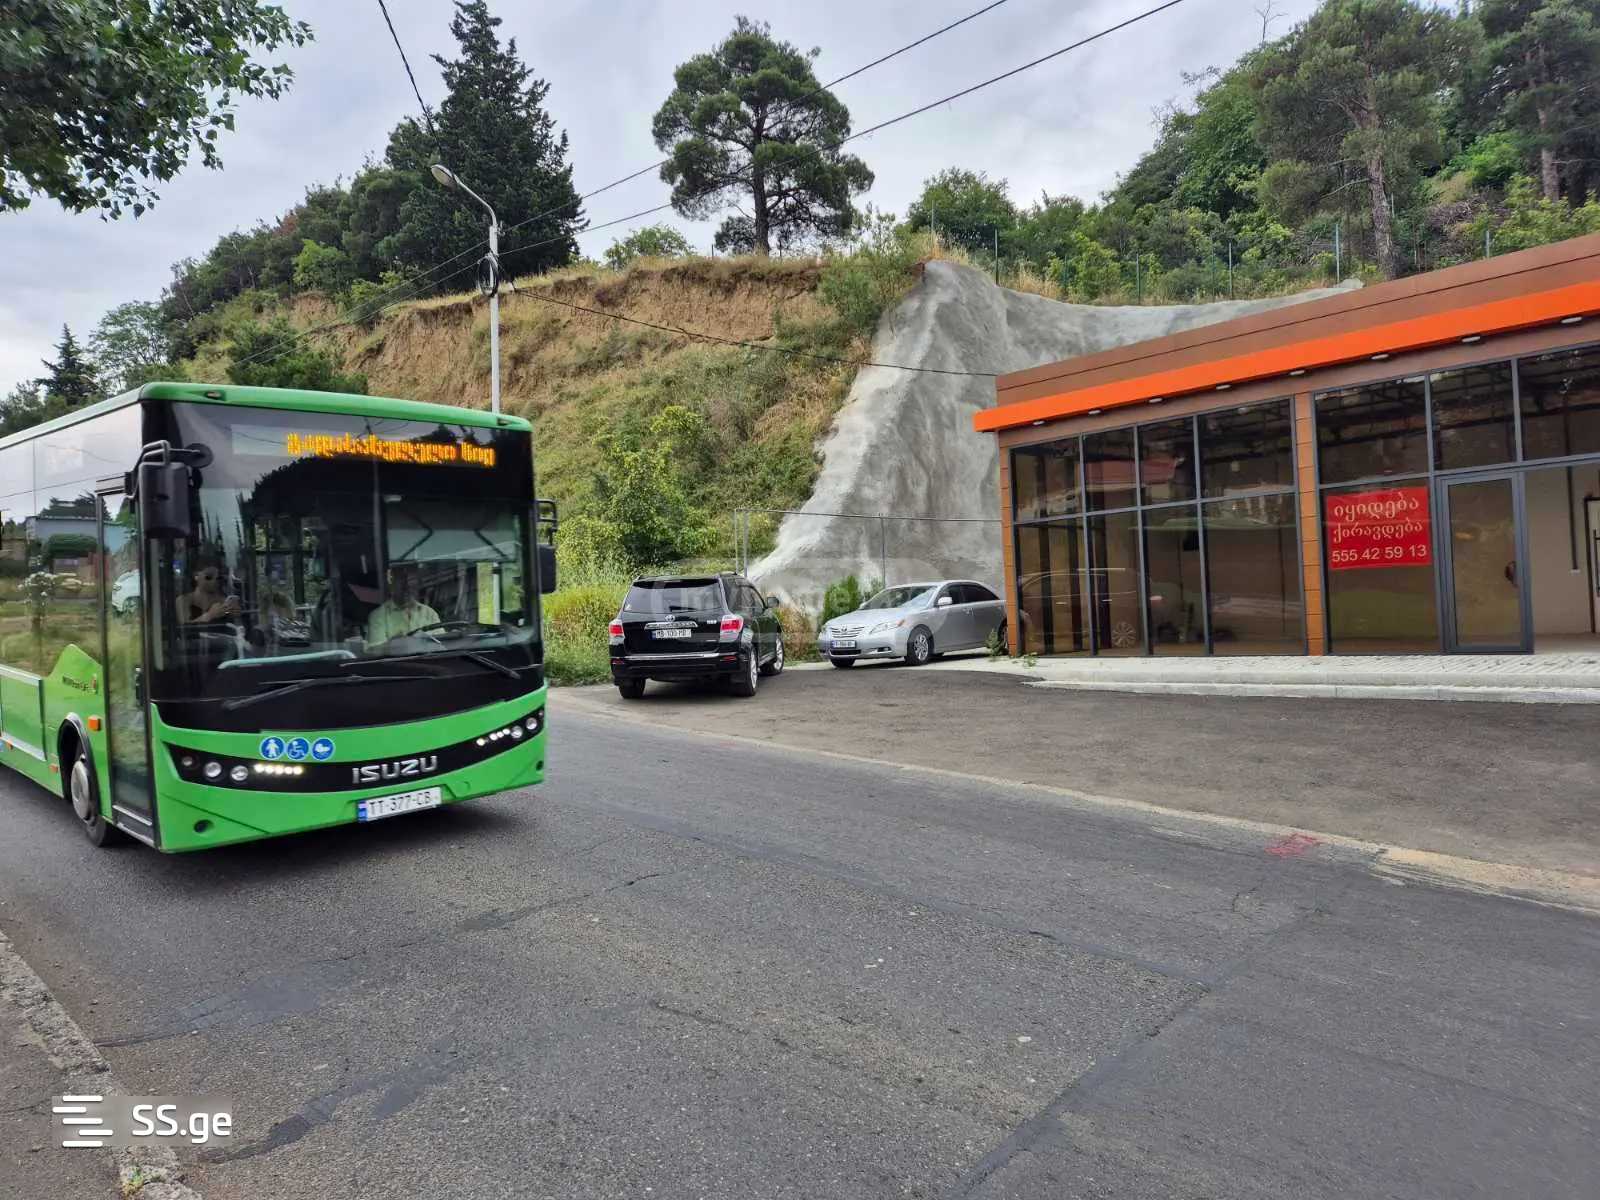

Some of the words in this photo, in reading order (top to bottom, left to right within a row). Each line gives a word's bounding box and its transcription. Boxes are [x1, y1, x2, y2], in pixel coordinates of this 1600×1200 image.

[1333, 492, 1420, 522] იყიდება
[1333, 517, 1423, 543] ქირავდება
[1331, 549, 1359, 563] 555
[1384, 545, 1404, 560] 59
[1408, 543, 1428, 558] 13
[352, 755, 438, 784] ISUZU
